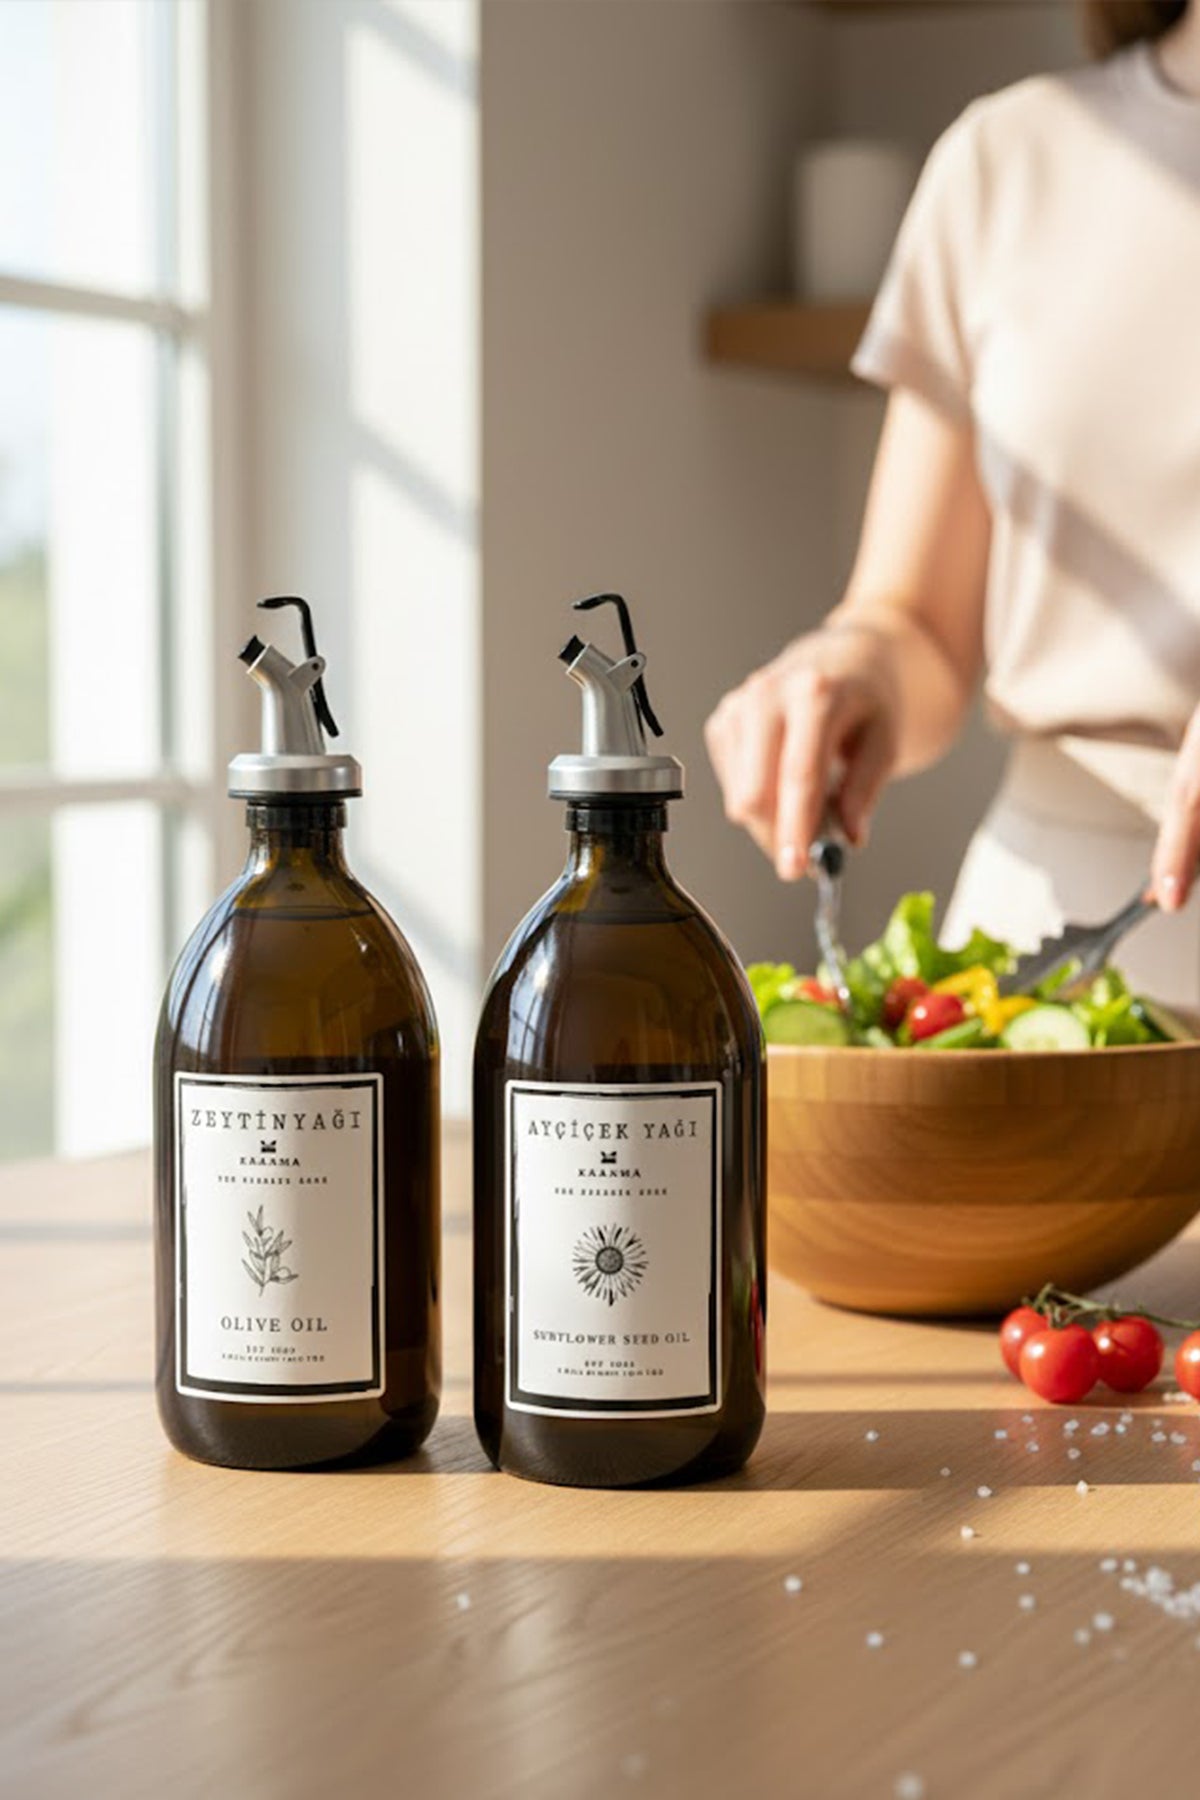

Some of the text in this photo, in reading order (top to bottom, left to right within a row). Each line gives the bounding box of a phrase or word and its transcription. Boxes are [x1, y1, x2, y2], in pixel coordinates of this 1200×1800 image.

[191, 1109, 361, 1130] ZEYTİNYAĞI
[528, 1119, 697, 1141] AYÇİÇEK YAĞI
[220, 1316, 328, 1332] OLIVE OIL
[623, 1333, 659, 1345] SEED
[664, 1332, 691, 1343] OIL
